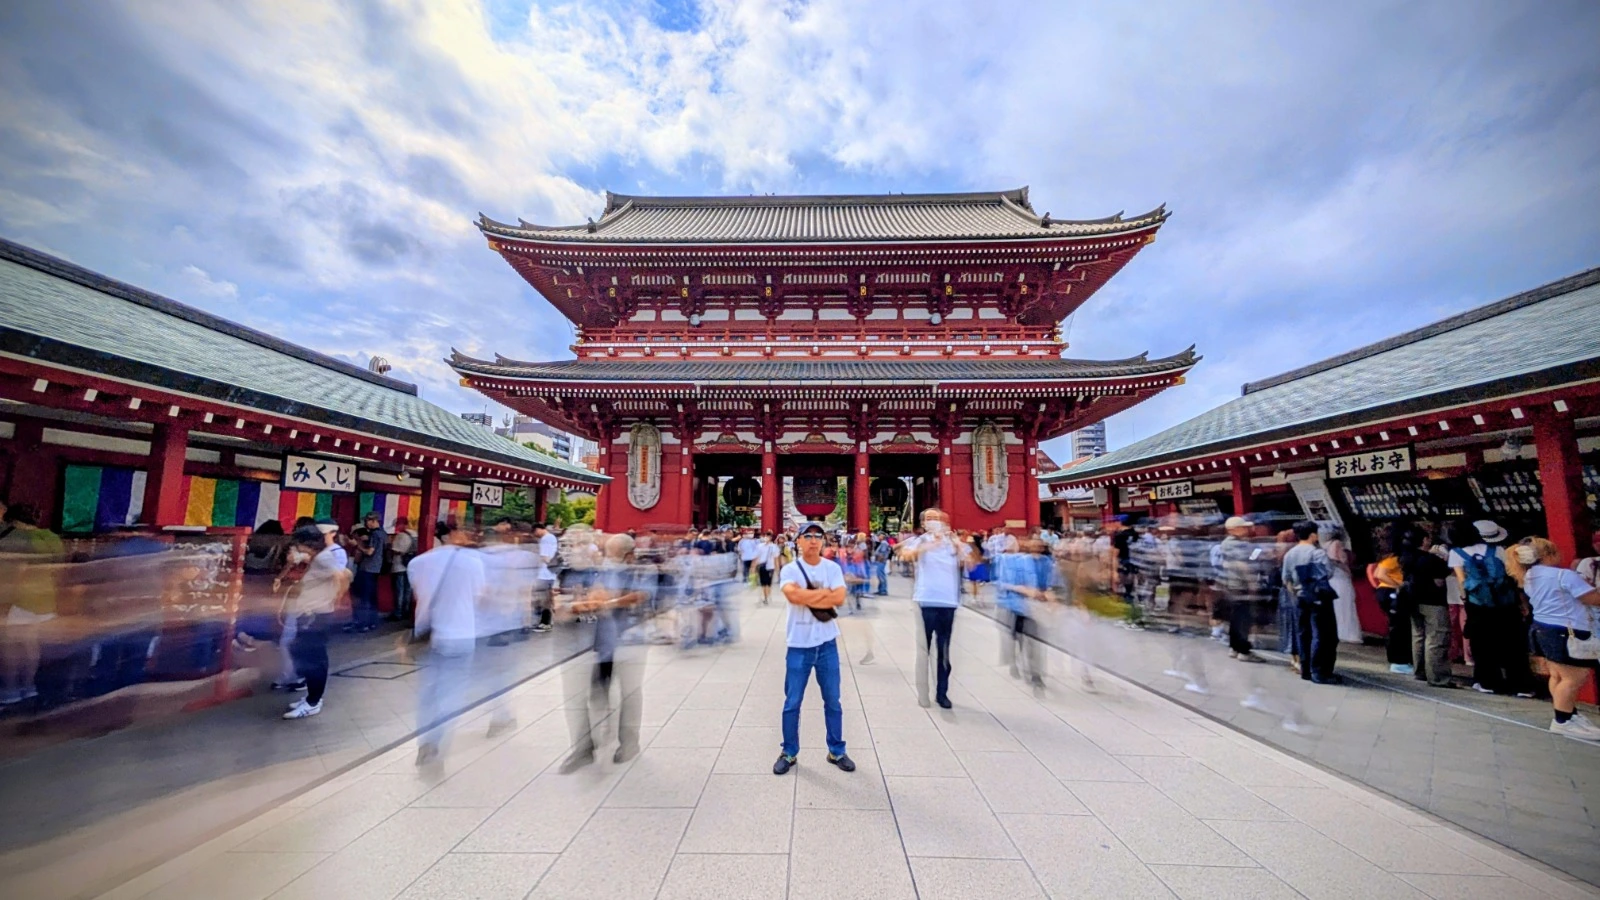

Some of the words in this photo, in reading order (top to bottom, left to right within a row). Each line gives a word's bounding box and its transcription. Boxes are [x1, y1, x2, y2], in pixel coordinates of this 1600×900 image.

[292, 462, 350, 485] みくじ
[1335, 451, 1405, 475] お札お守
